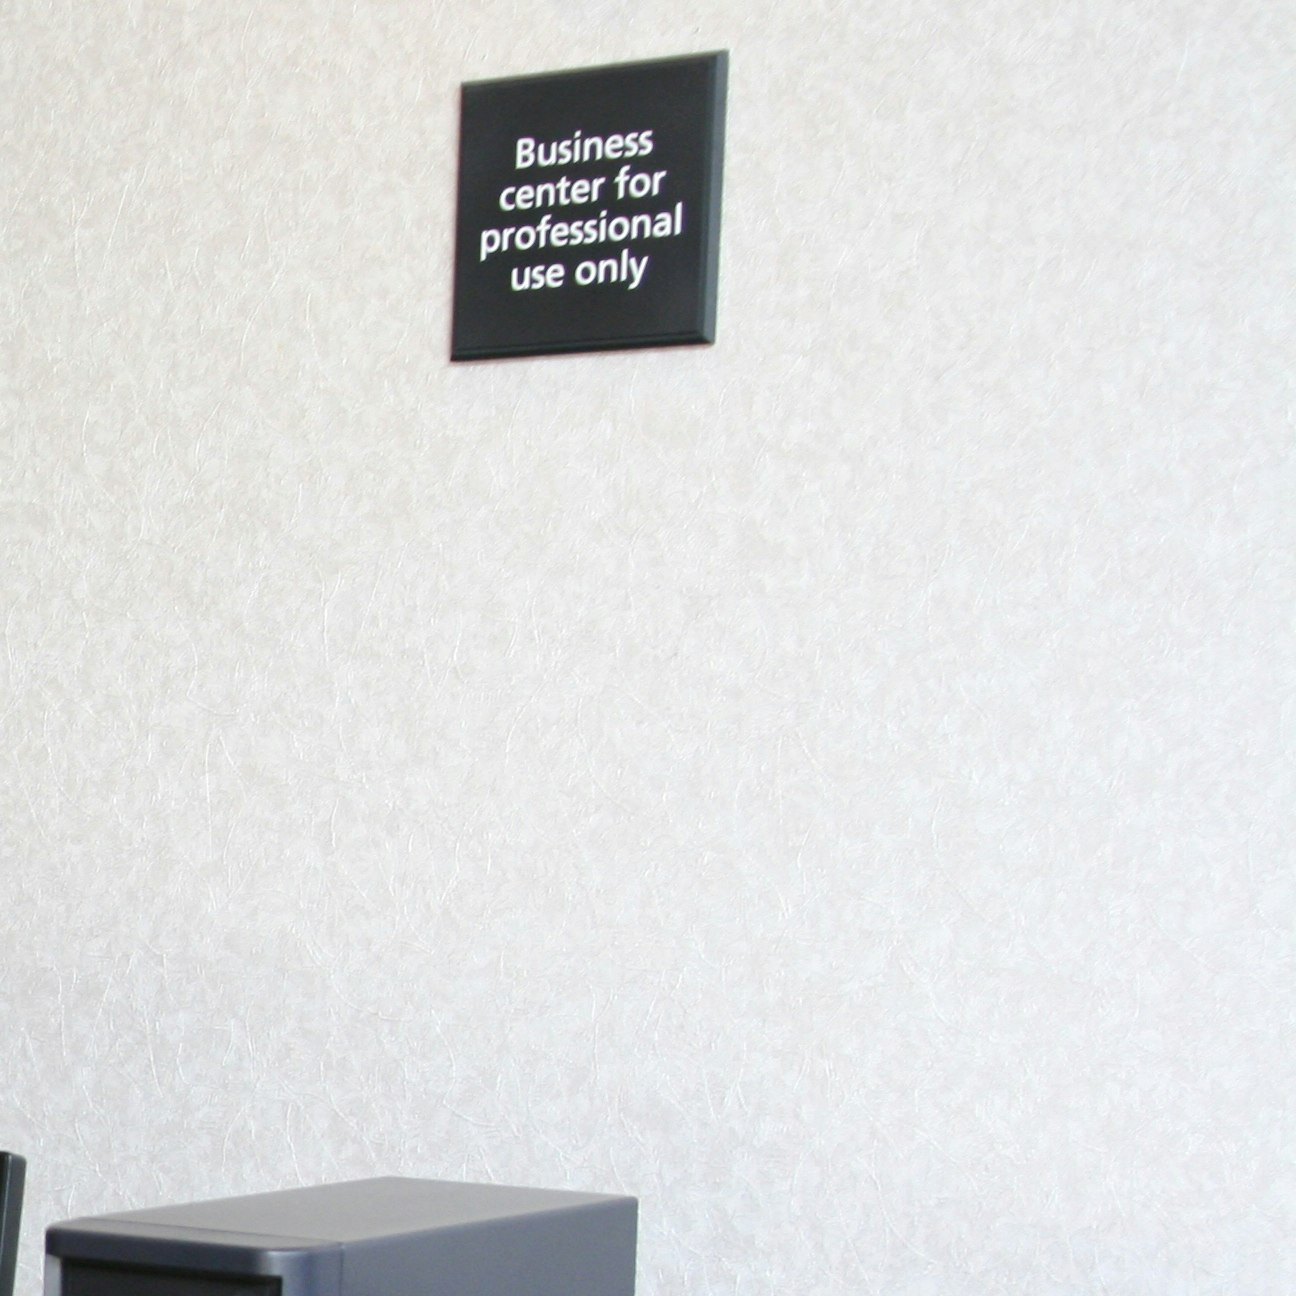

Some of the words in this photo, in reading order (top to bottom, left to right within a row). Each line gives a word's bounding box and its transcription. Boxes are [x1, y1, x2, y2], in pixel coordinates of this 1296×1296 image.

[515, 130, 654, 169] Business
[499, 176, 605, 211] center
[614, 165, 667, 200] for
[480, 201, 683, 262] professional
[511, 262, 565, 291] use
[575, 248, 649, 290] only
